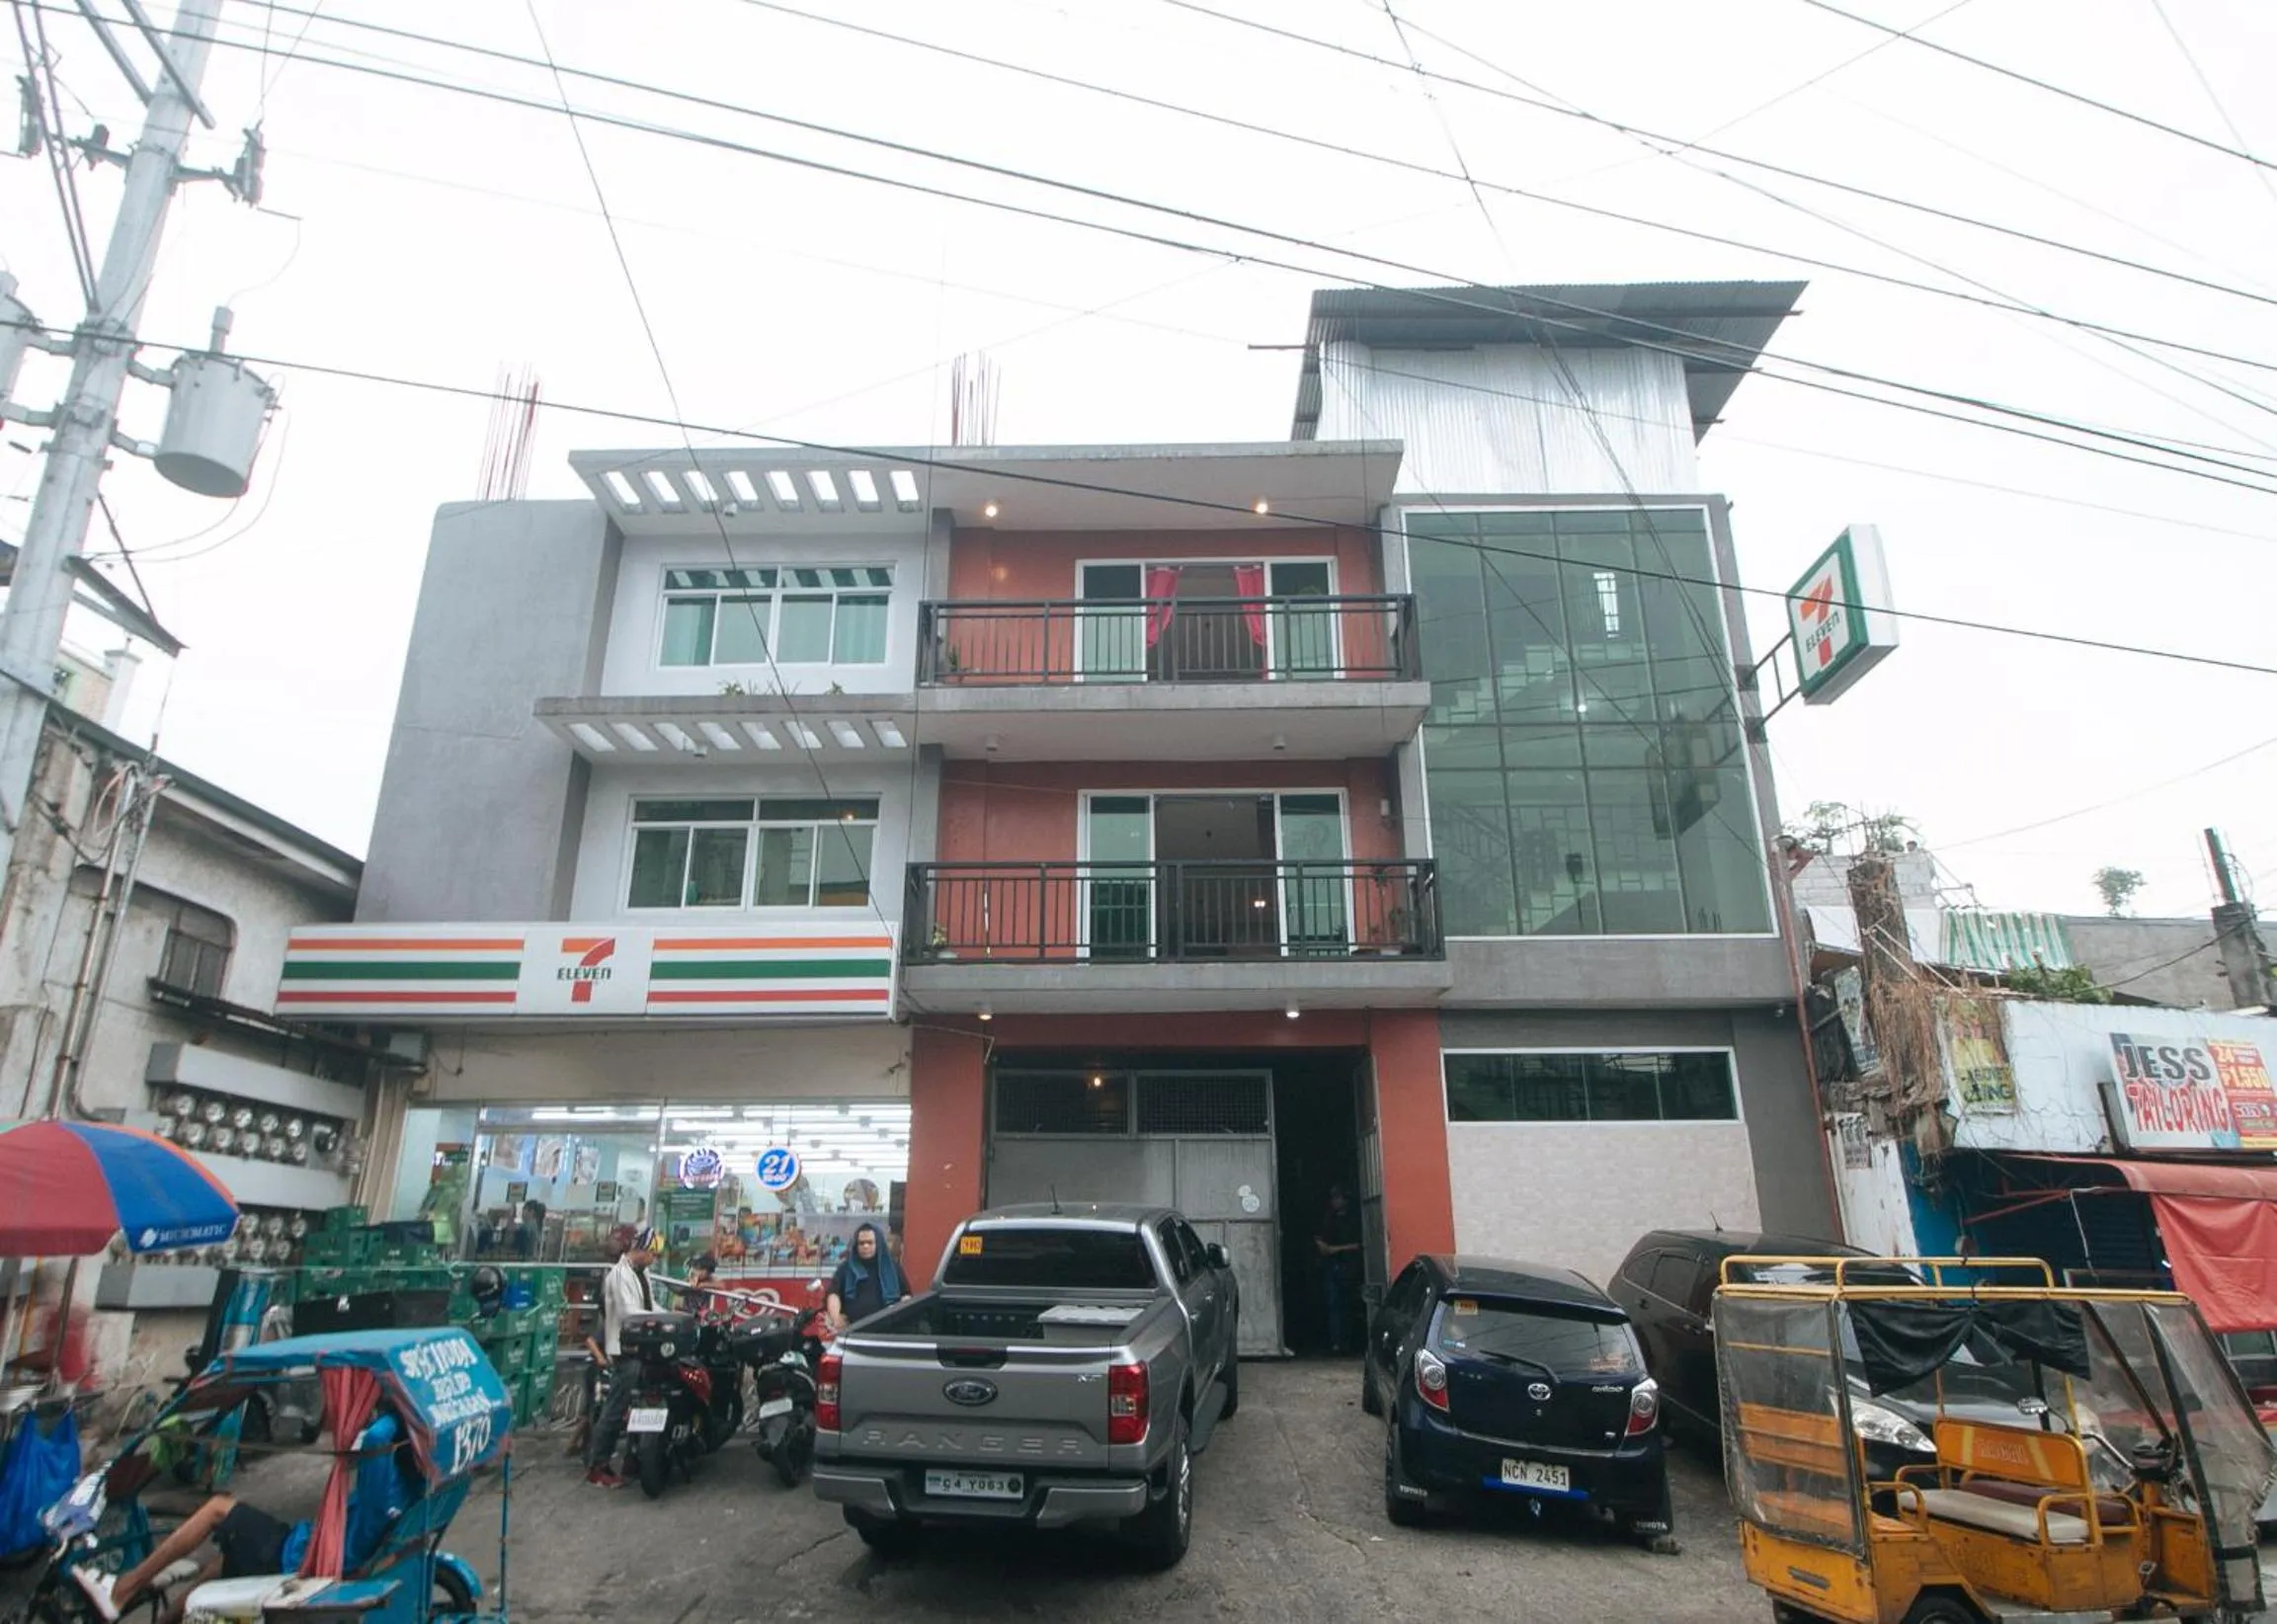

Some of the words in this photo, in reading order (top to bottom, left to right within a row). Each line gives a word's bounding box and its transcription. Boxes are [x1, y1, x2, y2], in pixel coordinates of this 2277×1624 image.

[1800, 574, 1834, 668] 7
[561, 936, 616, 1003] 7
[2123, 1045, 2211, 1081] JESS
[2125, 1084, 2230, 1134] TAILORING
[863, 1430, 1083, 1455] RANGER
[1504, 1464, 1528, 1480] NCN
[1536, 1468, 1568, 1486] 2451
